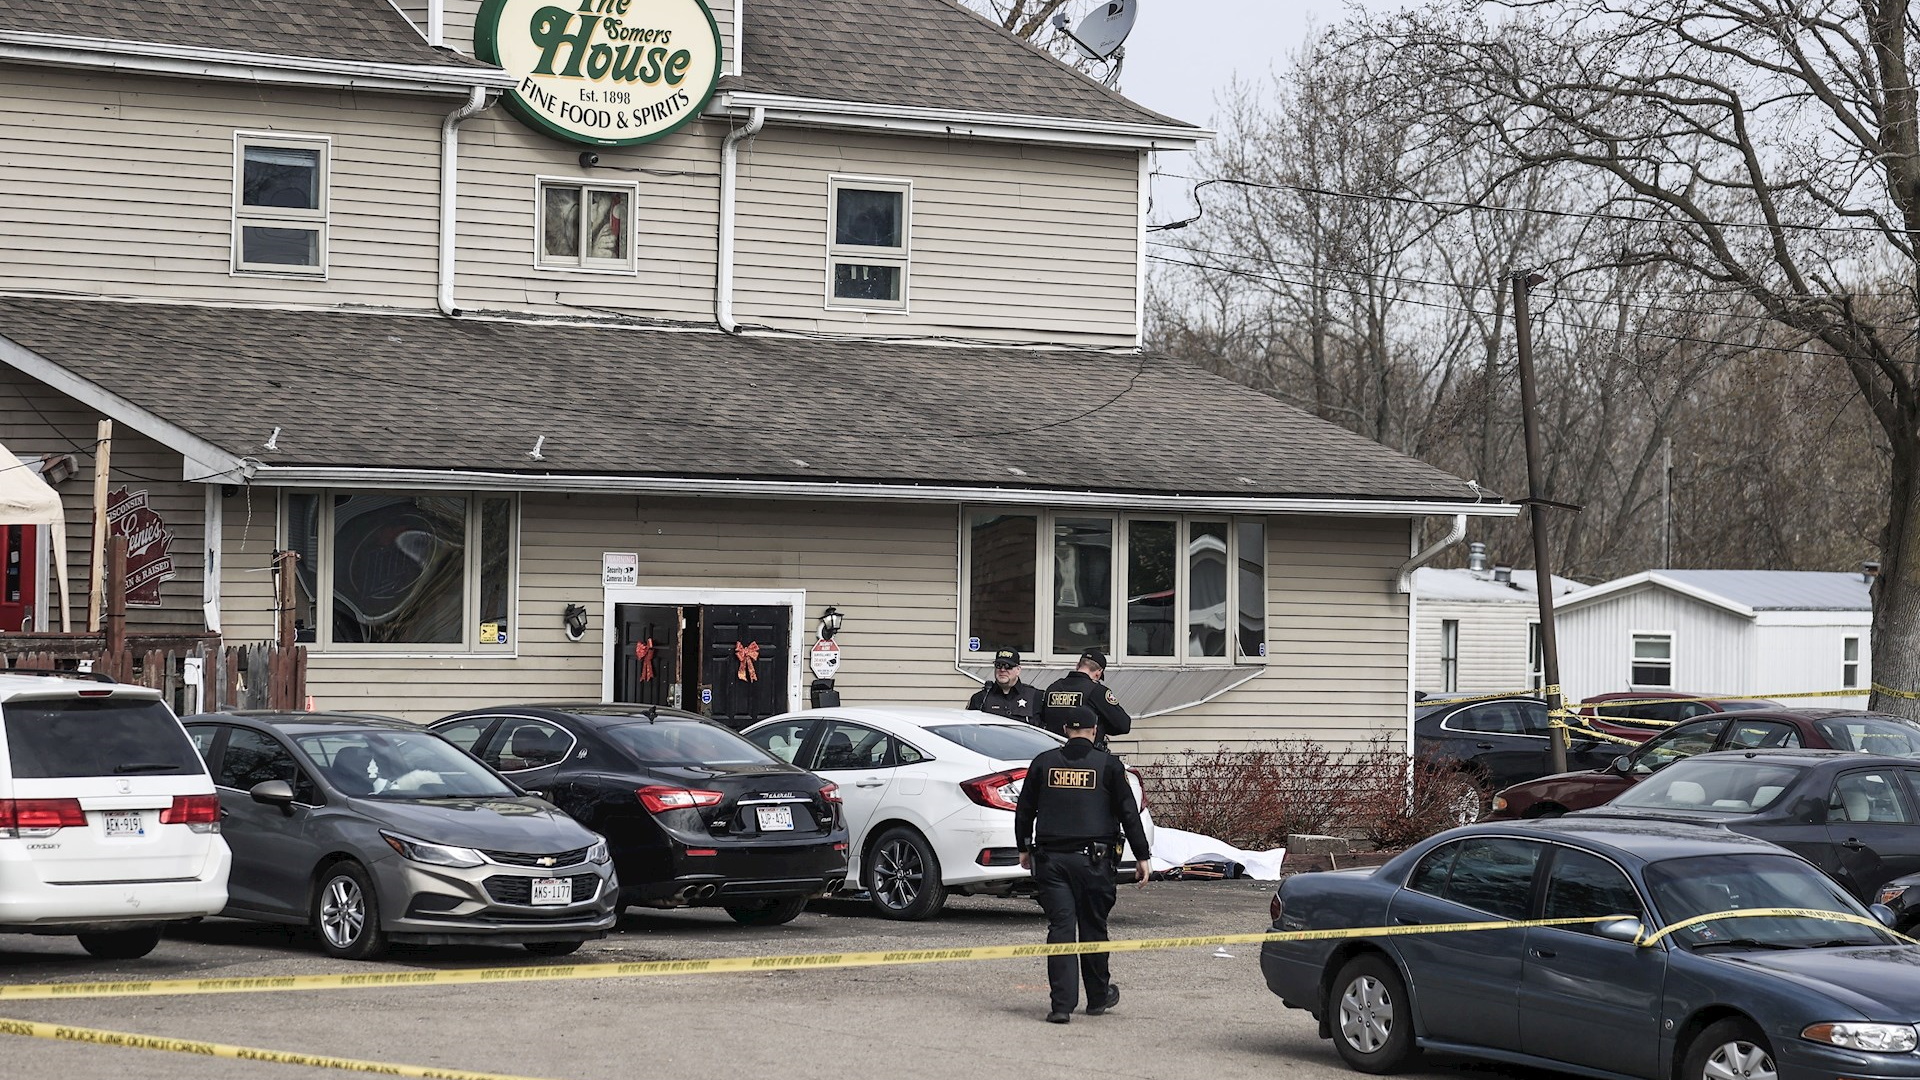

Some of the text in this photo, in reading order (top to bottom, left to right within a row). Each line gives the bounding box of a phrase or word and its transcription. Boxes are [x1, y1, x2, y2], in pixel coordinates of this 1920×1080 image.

[603, 17, 672, 44] Somers
[530, 6, 691, 86] House
[521, 77, 690, 129] FINE FOOD & SPIRITS
[580, 88, 631, 105] Est. 1898
[108, 496, 144, 520] ISCONSIN
[142, 561, 170, 580] RAISED
[1051, 693, 1078, 705] SHERIFF
[1053, 770, 1090, 787] SHERIFF
[106, 817, 142, 831] AEK-9191
[534, 886, 571, 899] AKS-1177
[55, 1028, 96, 1043] POLICE
[237, 1049, 280, 1062] POLICE
